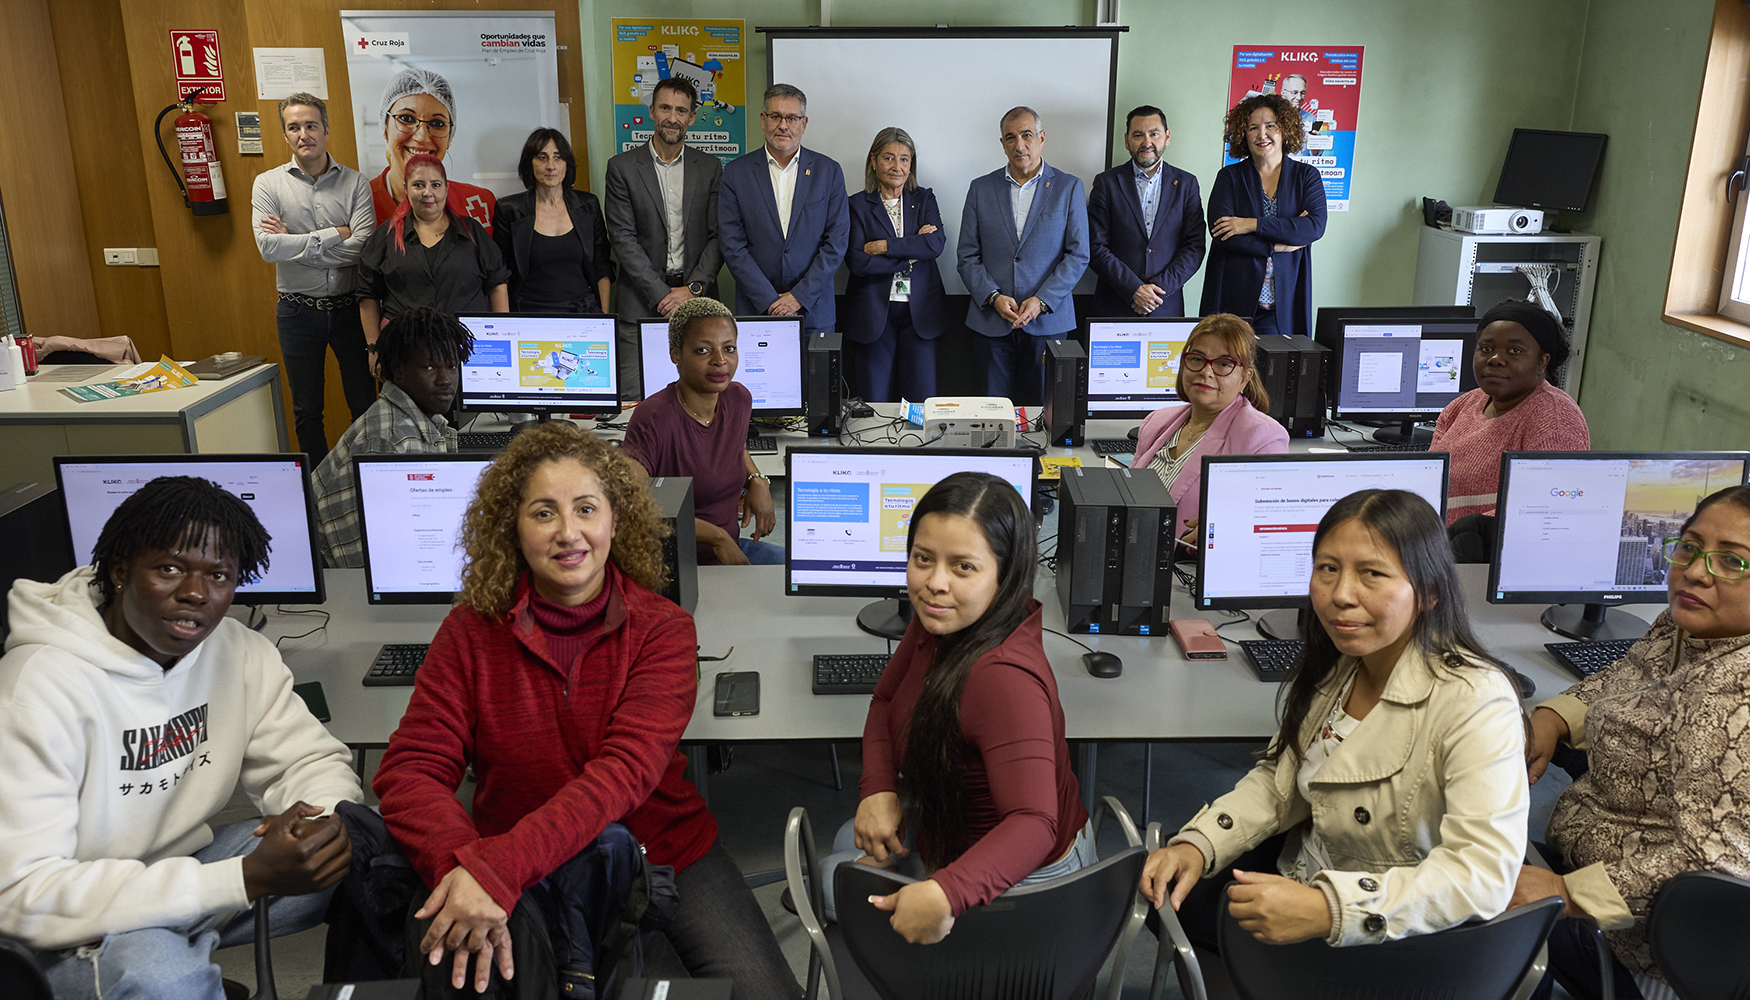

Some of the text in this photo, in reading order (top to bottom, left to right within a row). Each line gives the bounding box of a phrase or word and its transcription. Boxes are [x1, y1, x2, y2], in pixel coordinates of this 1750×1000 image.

[481, 39, 546, 47] cambian vidas
[1550, 487, 1583, 499] Google
